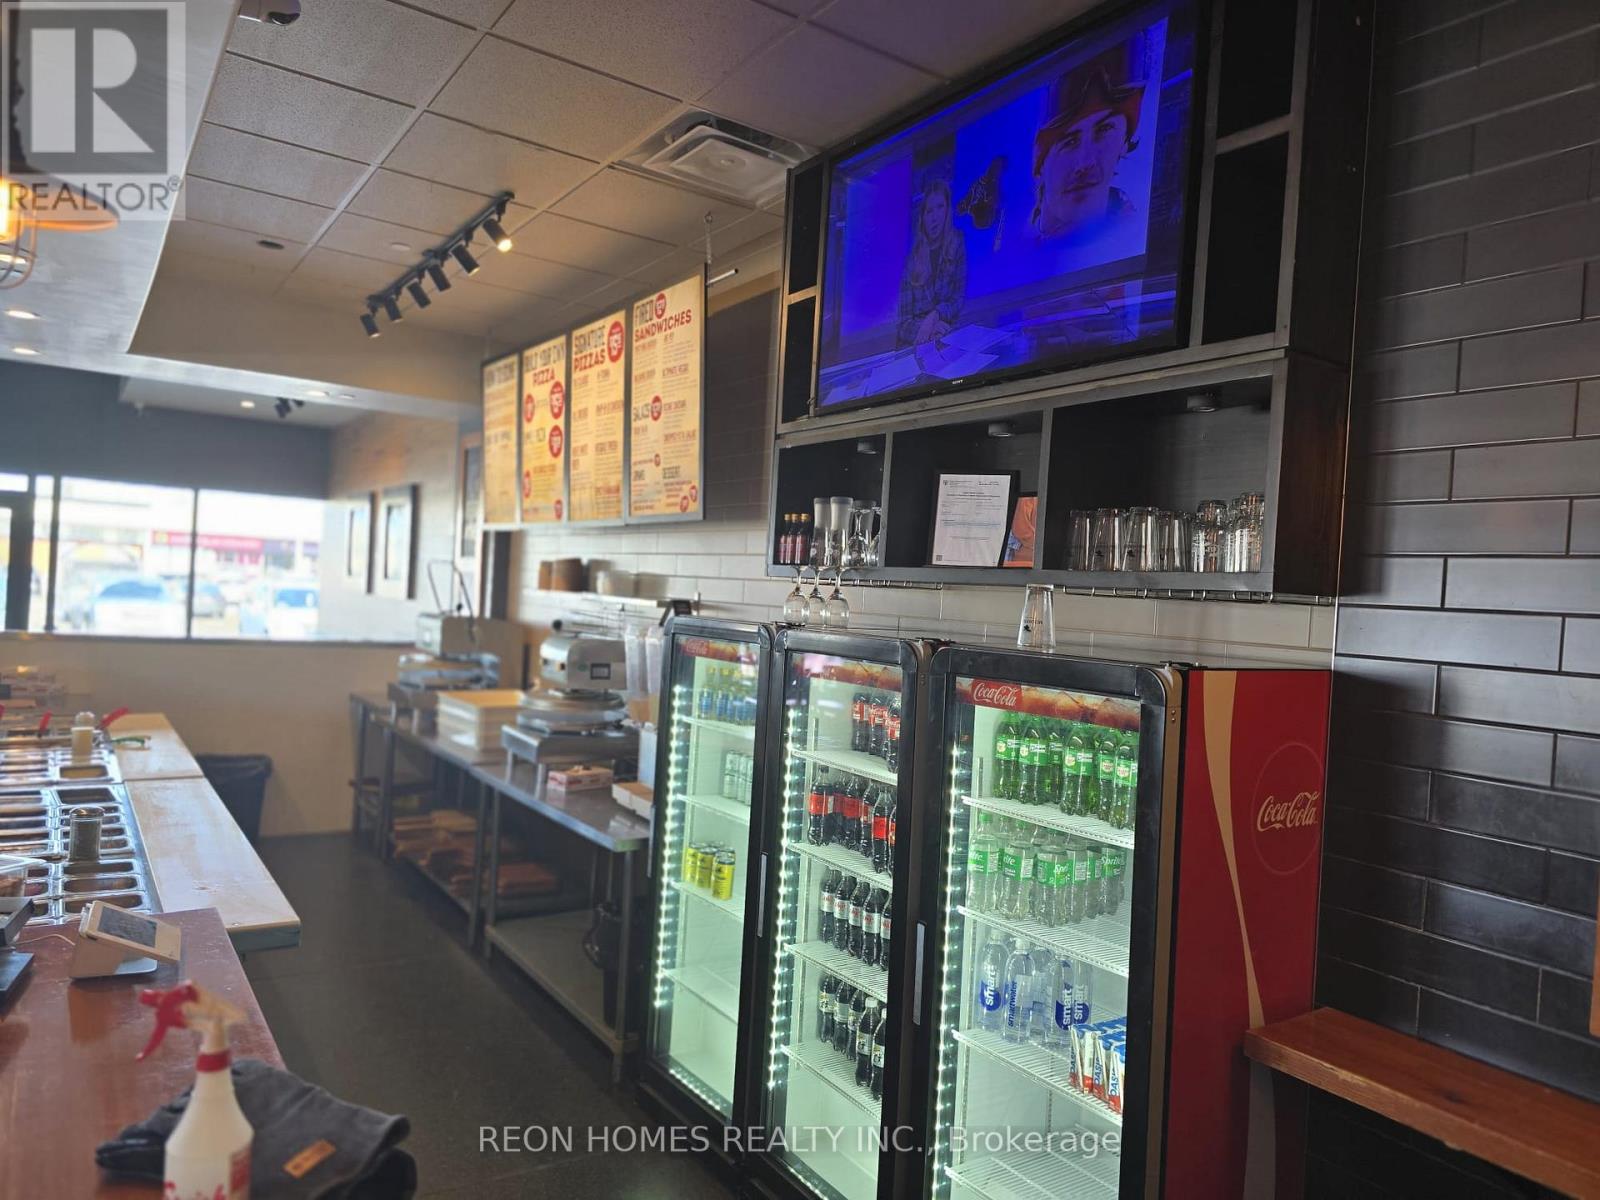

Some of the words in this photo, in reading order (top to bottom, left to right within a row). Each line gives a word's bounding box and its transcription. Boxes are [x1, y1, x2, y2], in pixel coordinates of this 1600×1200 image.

[634, 309, 692, 342] SANDWICHES
[574, 348, 606, 373] PIZZAS
[973, 682, 1017, 707] Coca-Cola
[1256, 791, 1320, 832] Coca-Cola
[1062, 987, 1073, 1026] smart
[1073, 983, 1085, 1021] smart
